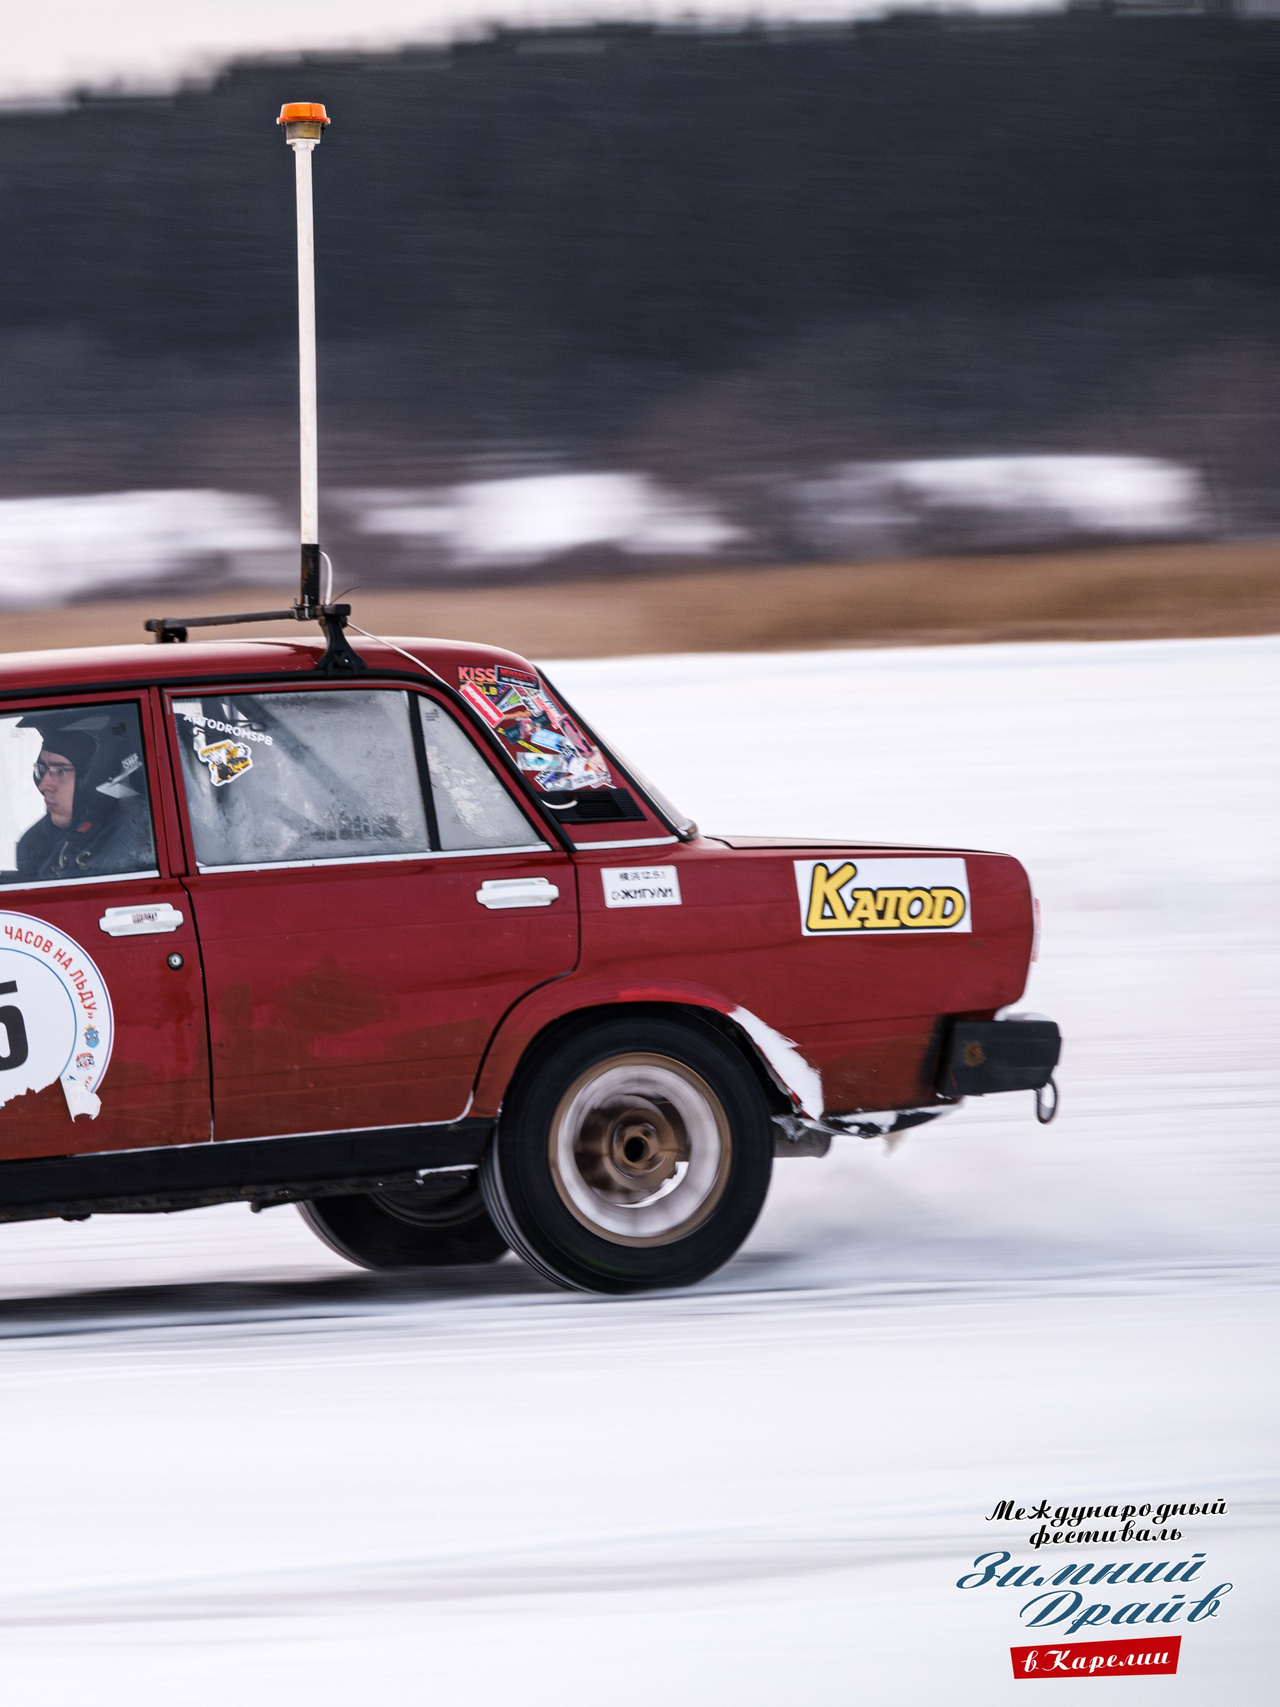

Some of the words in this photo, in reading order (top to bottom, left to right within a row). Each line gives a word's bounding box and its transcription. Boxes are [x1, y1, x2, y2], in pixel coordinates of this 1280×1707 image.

[458, 666, 496, 683] KISS
[183, 715, 274, 746] ATODROMSPB
[806, 862, 966, 932] KATOD
[4, 925, 53, 954] ЧАСОВ
[53, 948, 73, 970] НА
